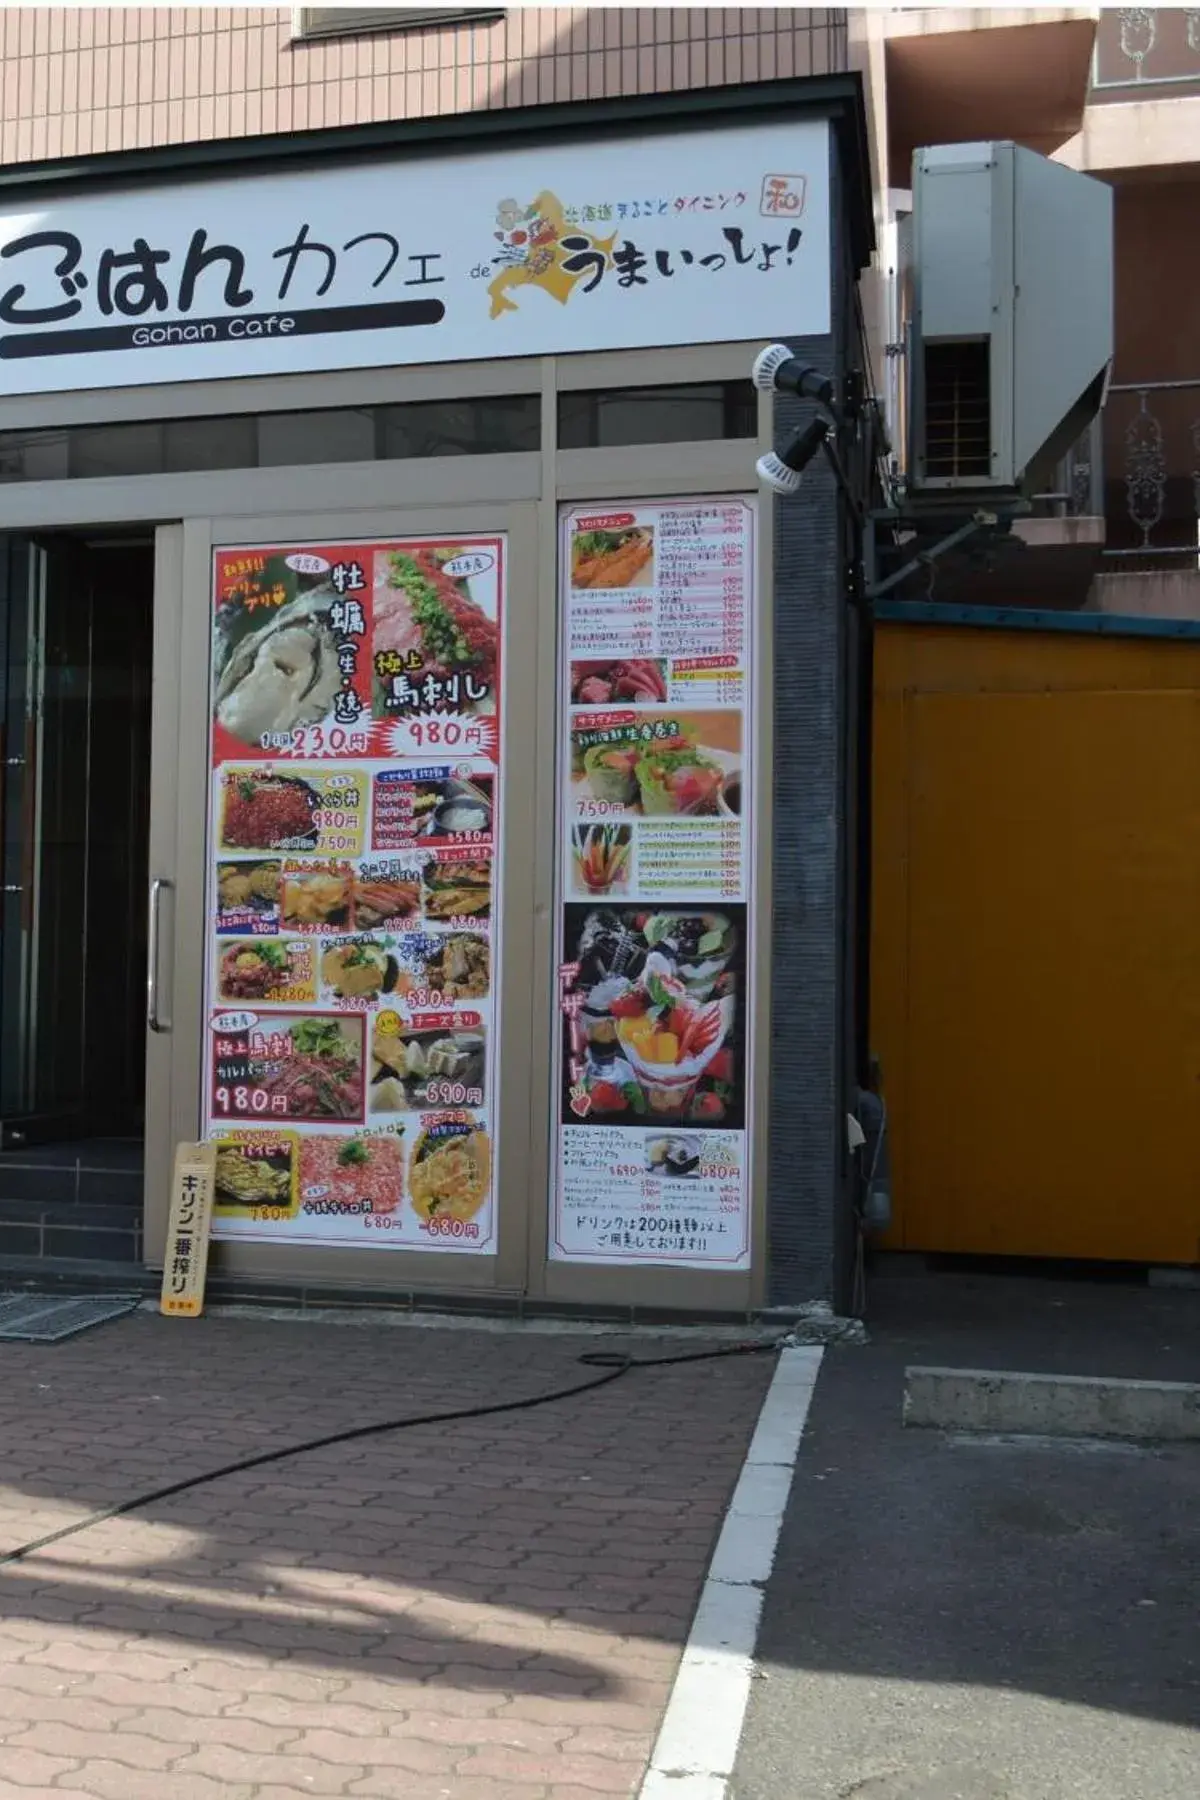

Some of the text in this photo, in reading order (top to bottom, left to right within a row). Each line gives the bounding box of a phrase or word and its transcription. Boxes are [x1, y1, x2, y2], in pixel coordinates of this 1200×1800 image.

[470, 264, 491, 278] de
[132, 316, 296, 346] Gohan Cafe
[375, 651, 424, 676] 極上
[386, 674, 489, 708] 馬刺し
[408, 723, 482, 746] 980円
[311, 810, 358, 829] 980円
[215, 1087, 288, 1112] 980円
[171, 1174, 199, 1294] キリン一番搾り
